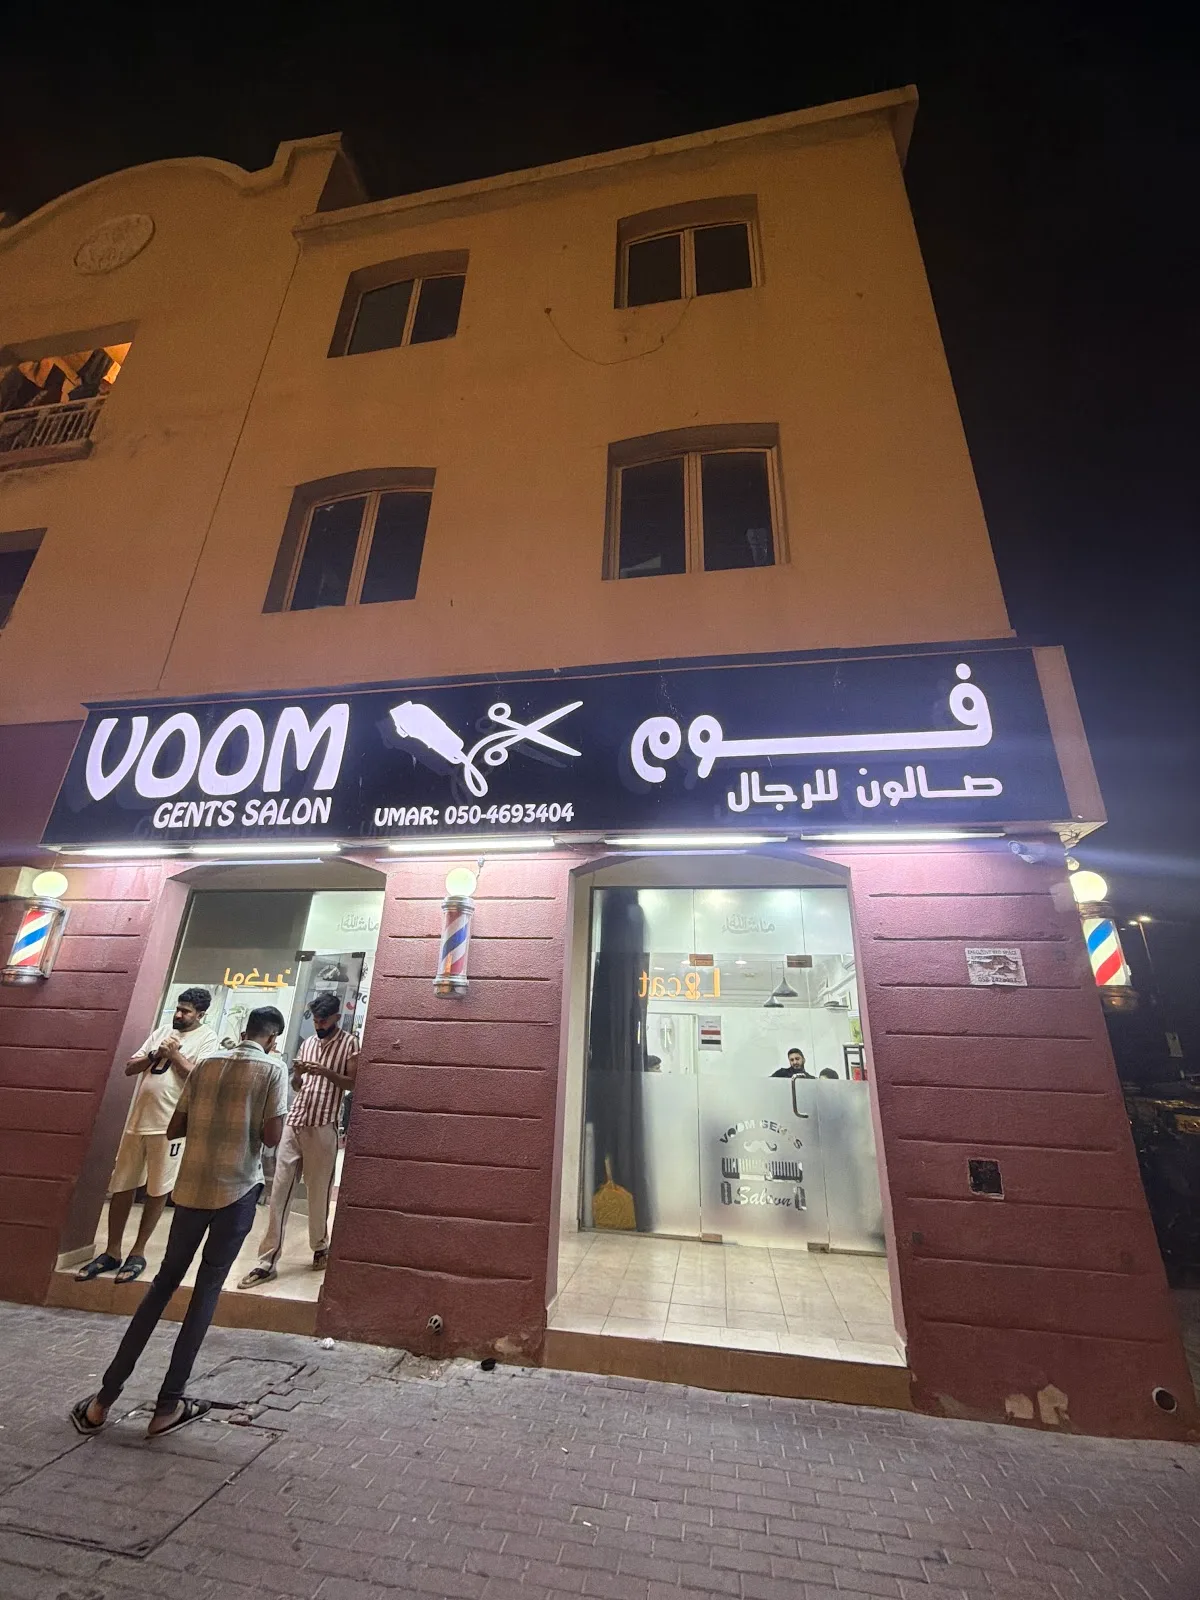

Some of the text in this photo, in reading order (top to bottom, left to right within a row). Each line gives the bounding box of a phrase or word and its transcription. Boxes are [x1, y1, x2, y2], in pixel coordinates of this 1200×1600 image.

[85, 703, 350, 801] VOOM
[726, 765, 1004, 813] صالون للرجال
[152, 796, 333, 829] GENTS SALON
[374, 802, 575, 827] UMAR: 050-4693404
[169, 1142, 182, 1157] U
